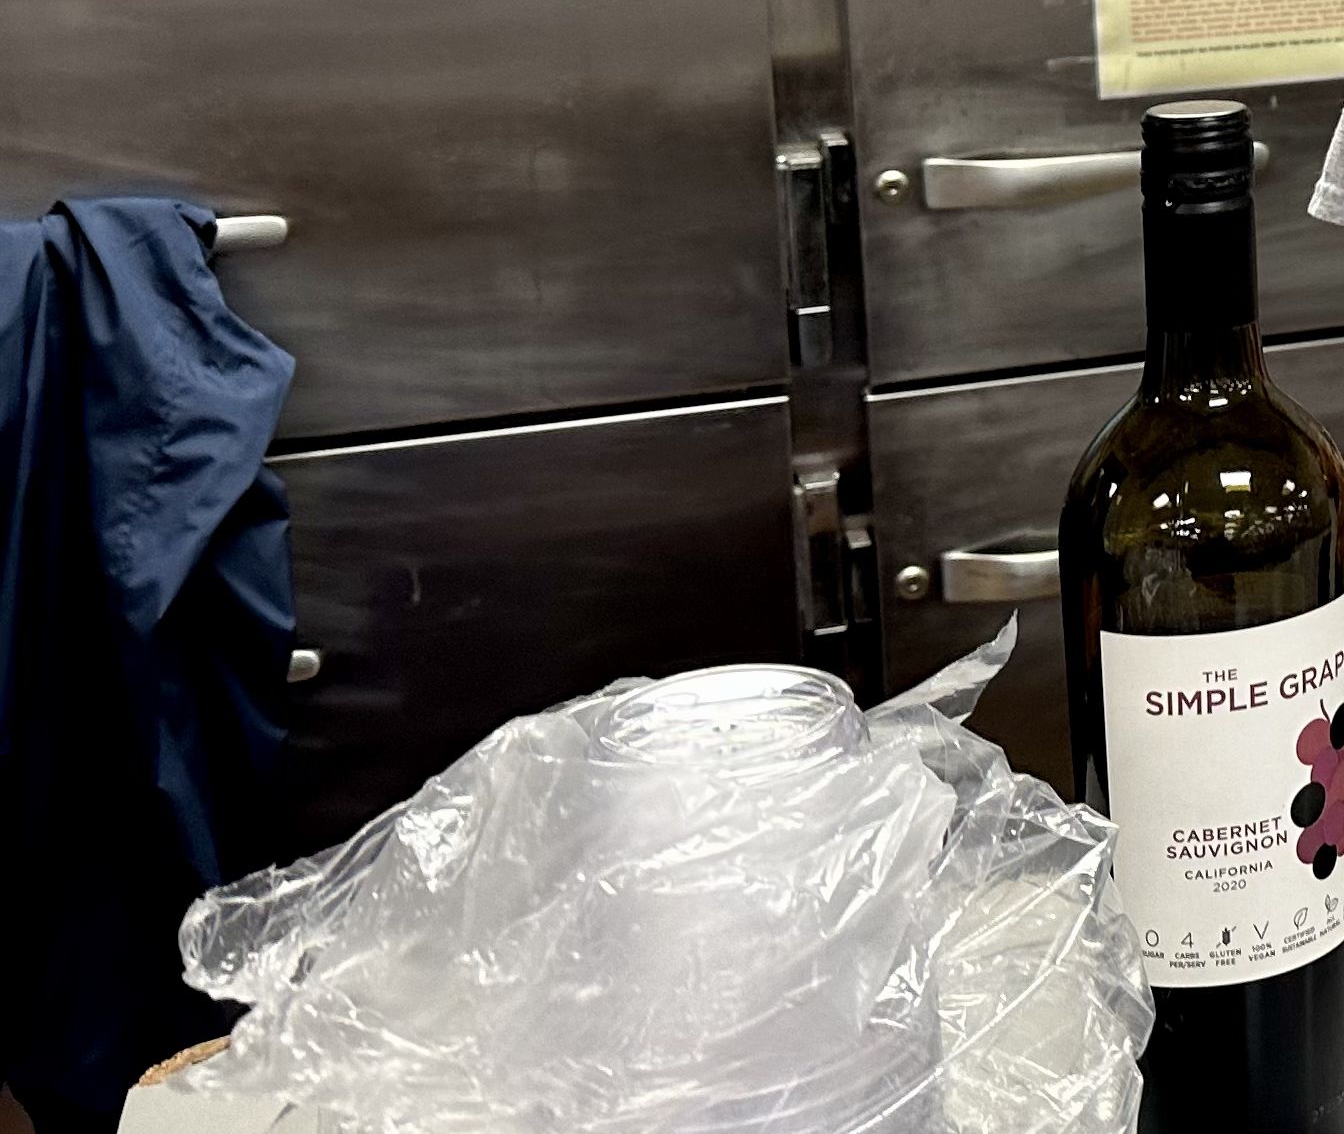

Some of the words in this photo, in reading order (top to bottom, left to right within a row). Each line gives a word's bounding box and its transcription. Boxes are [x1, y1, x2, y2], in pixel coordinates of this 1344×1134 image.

[1202, 668, 1238, 684] THE
[1145, 681, 1269, 717] SIMPLE
[1173, 816, 1282, 844] CABERNET
[1166, 829, 1289, 860] SAUVIGNON
[1184, 860, 1274, 882] CALIFORNIA
[1212, 879, 1247, 893] 2020
[1181, 931, 1194, 949] 4
[1209, 949, 1242, 959] GLUTEN
[1215, 958, 1236, 967] FREE
[1249, 950, 1276, 962] VEGAN
